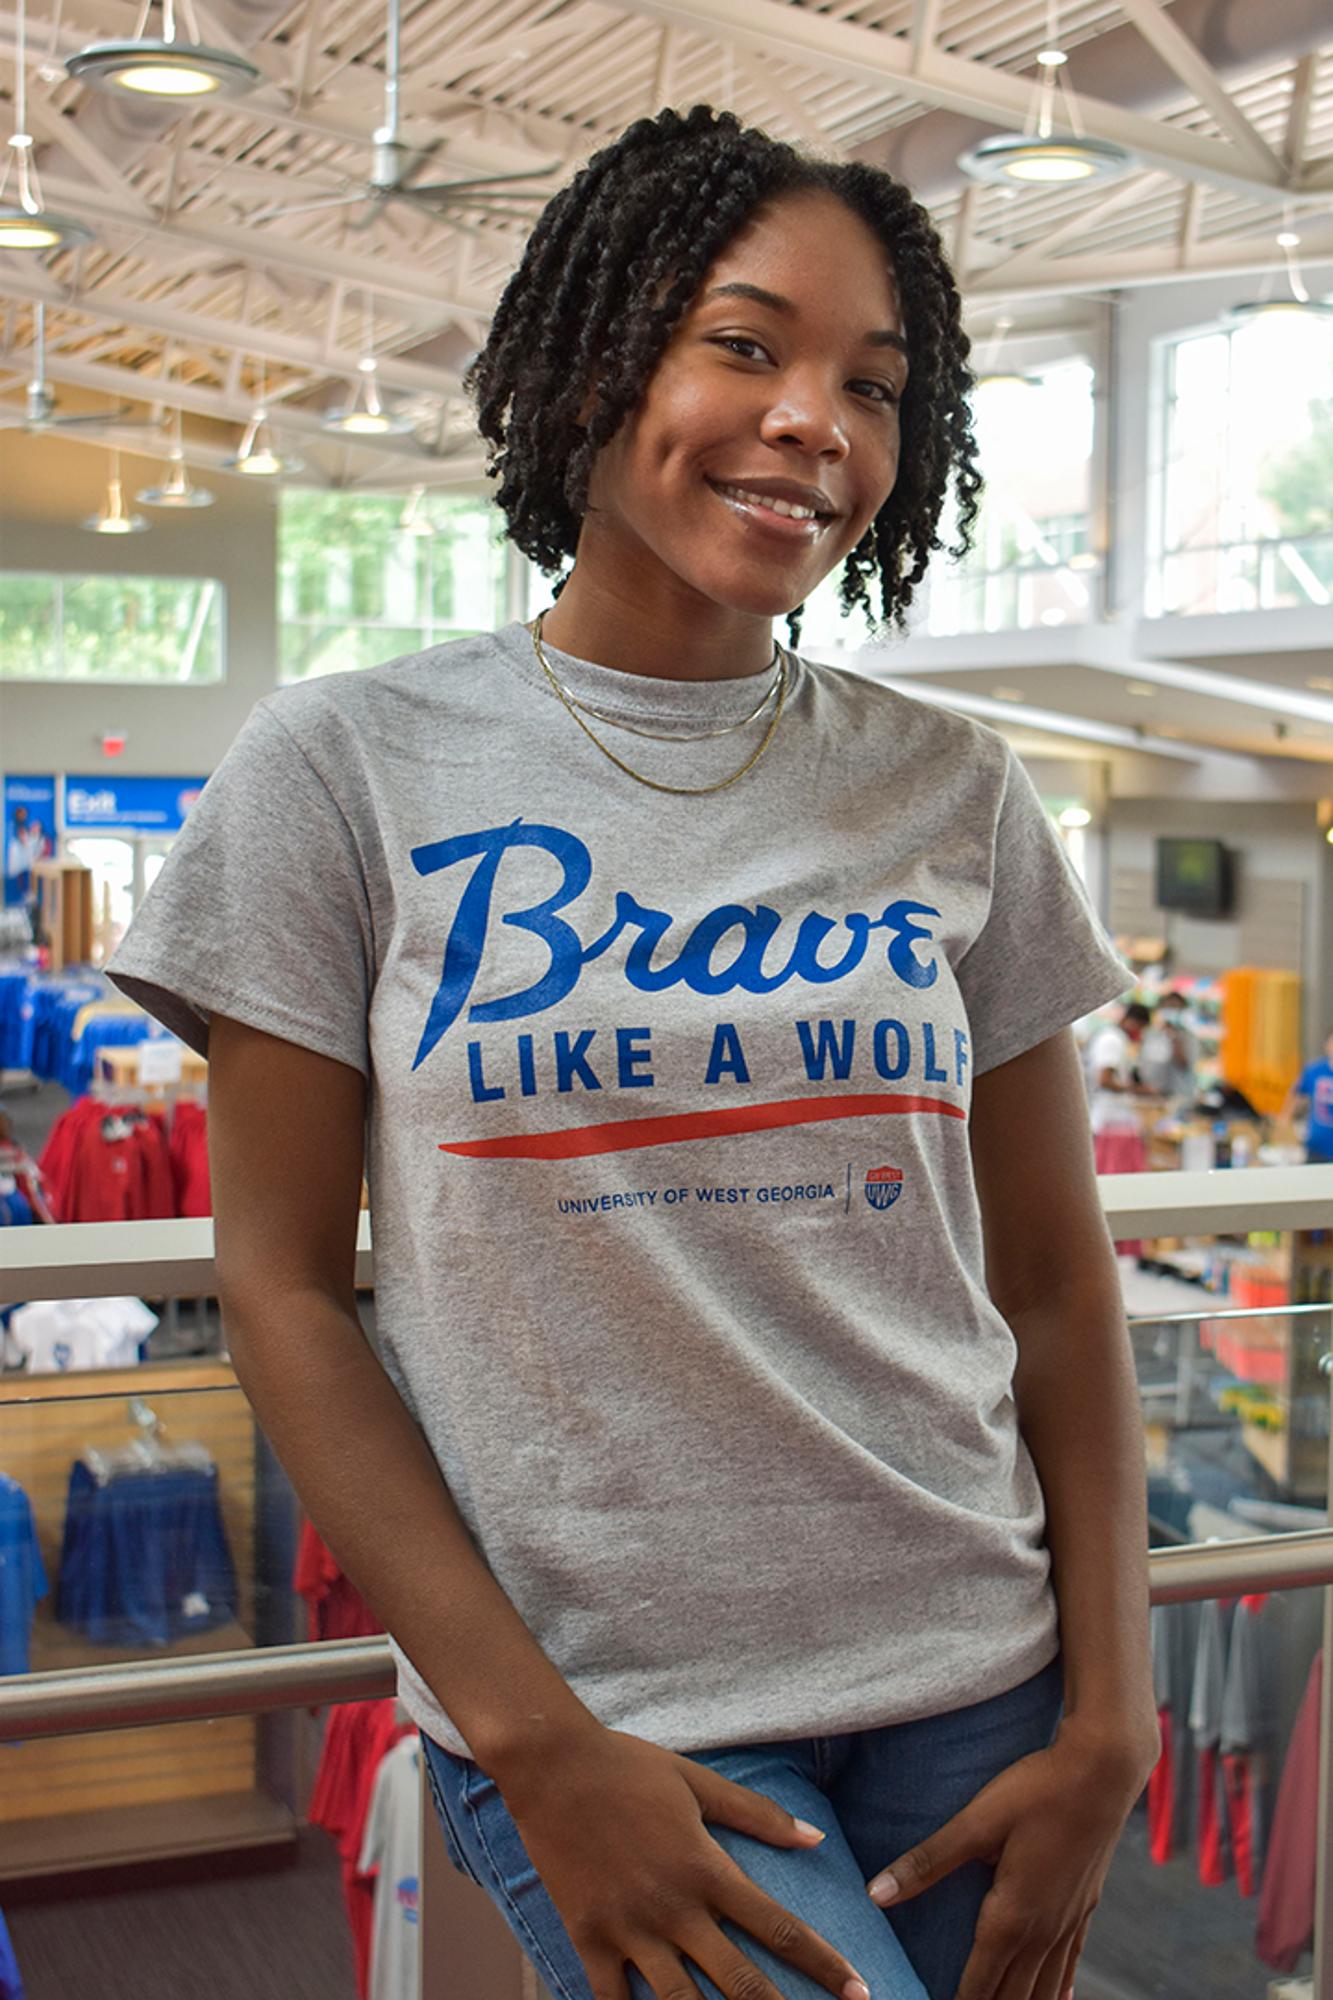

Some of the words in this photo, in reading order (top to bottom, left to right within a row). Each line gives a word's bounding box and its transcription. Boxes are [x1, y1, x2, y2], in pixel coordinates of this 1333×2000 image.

[410, 817, 942, 1071] Brave
[467, 1028, 655, 1103] LIKE
[704, 1023, 750, 1084] A
[796, 1019, 967, 1087] WOLF
[558, 1190, 657, 1214] UNIVERSITY
[664, 1188, 687, 1204] OF
[695, 1188, 750, 1203] WEST
[756, 1184, 836, 1203] GEORGIA
[866, 1184, 899, 1207] UWG
